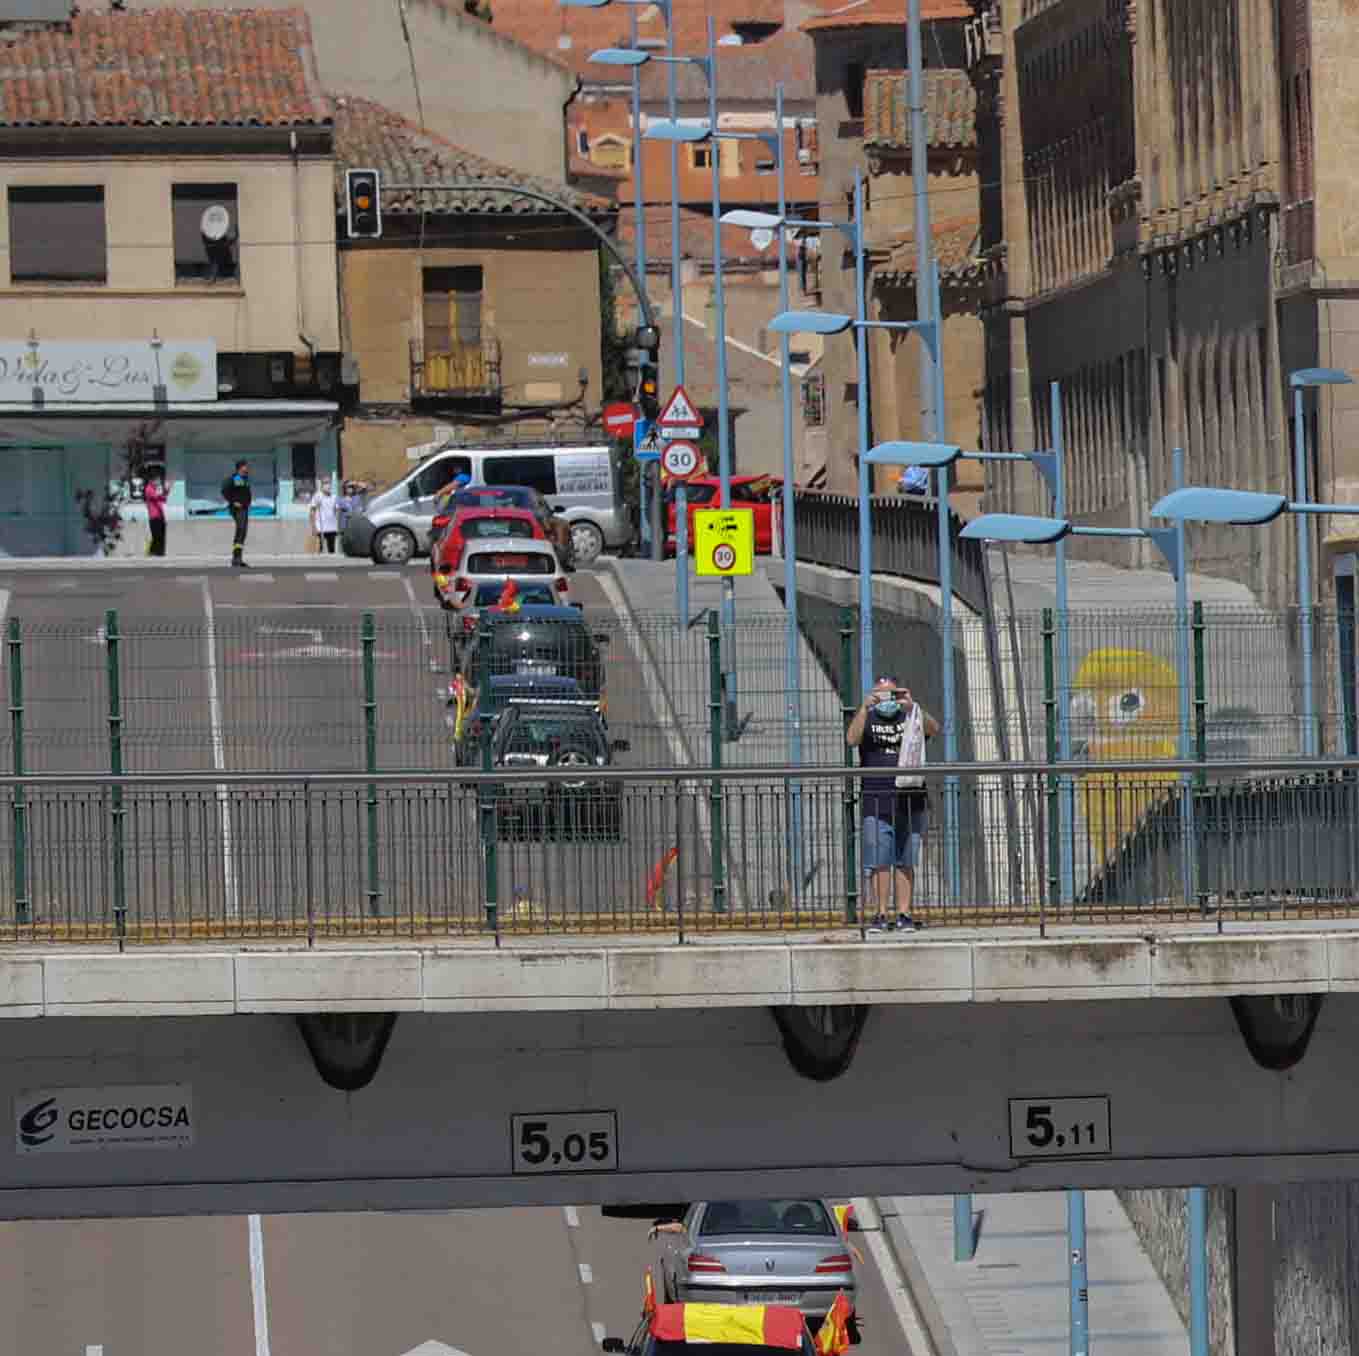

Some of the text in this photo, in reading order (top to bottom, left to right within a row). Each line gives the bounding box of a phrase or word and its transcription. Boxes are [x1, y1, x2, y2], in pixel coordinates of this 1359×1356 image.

[669, 453, 692, 467] 30
[68, 1106, 190, 1131] GECOCSA
[521, 1122, 609, 1165] 5,05
